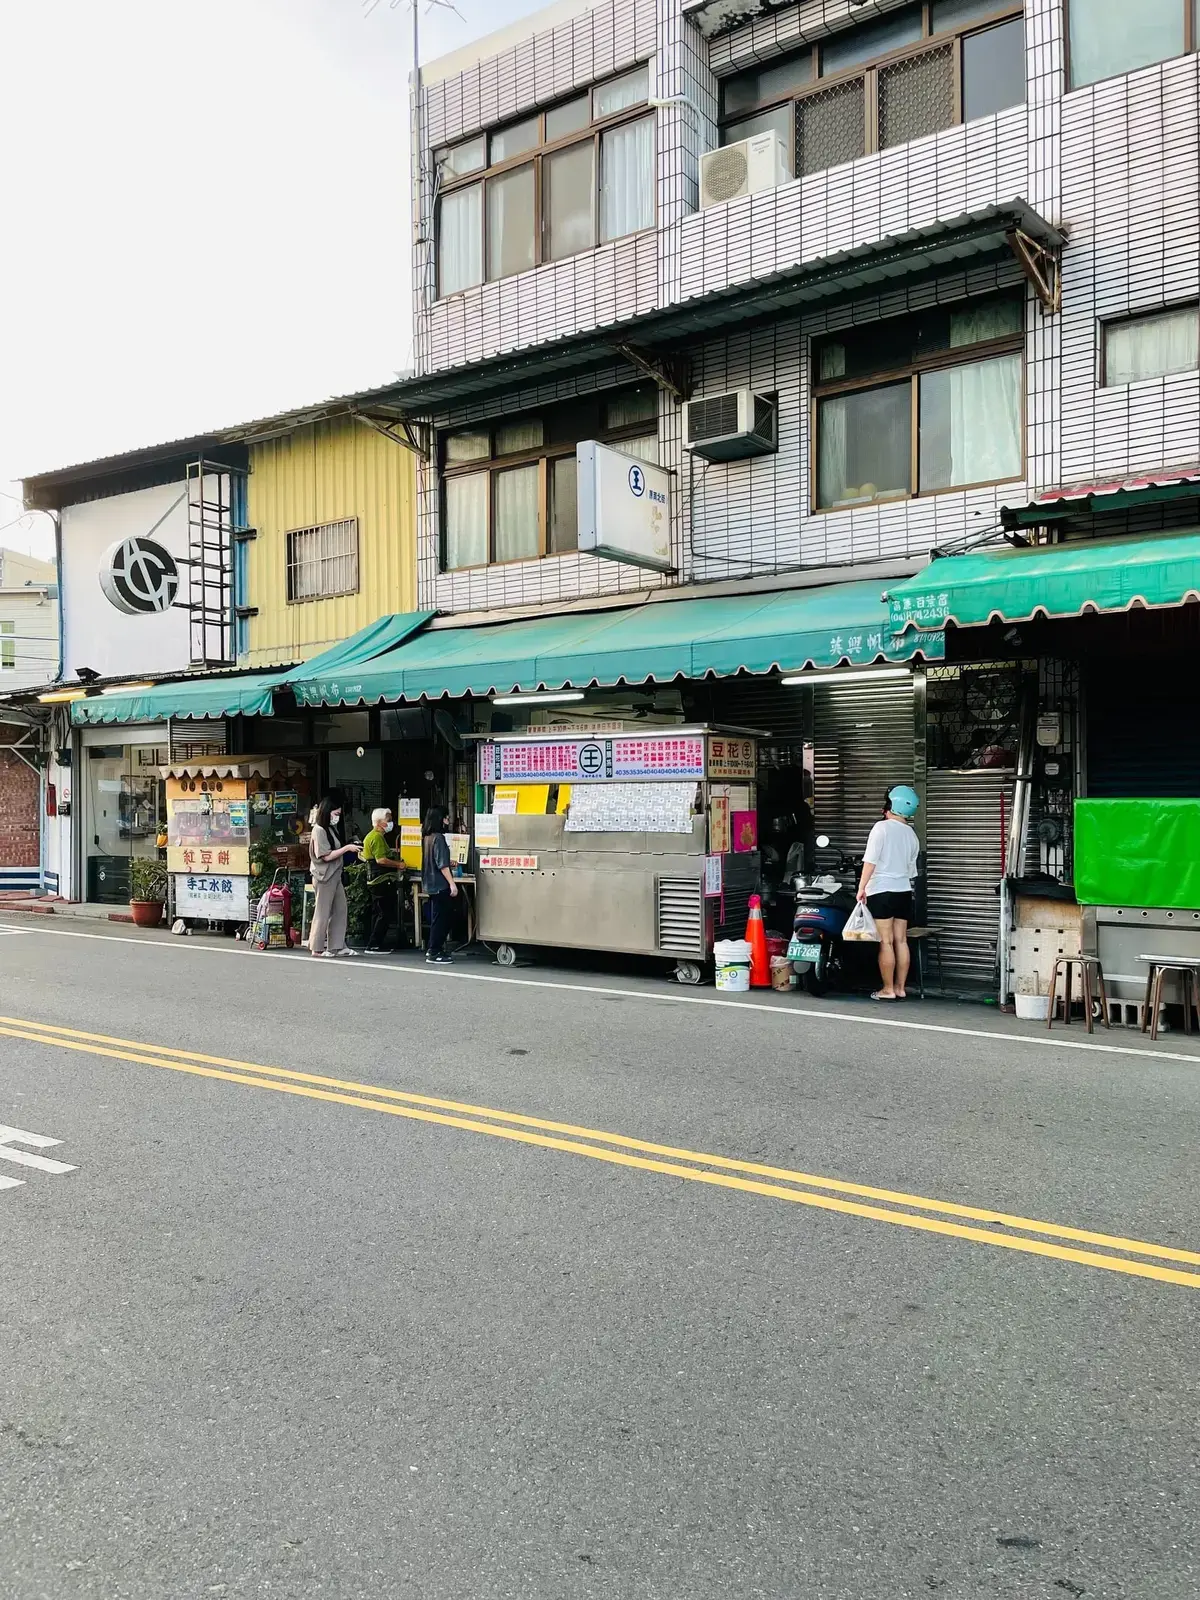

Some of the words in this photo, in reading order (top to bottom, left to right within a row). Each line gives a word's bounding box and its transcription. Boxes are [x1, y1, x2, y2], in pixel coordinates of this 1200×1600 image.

[183, 848, 230, 866] 紅豆餅
[187, 877, 233, 894] 手工水餃
